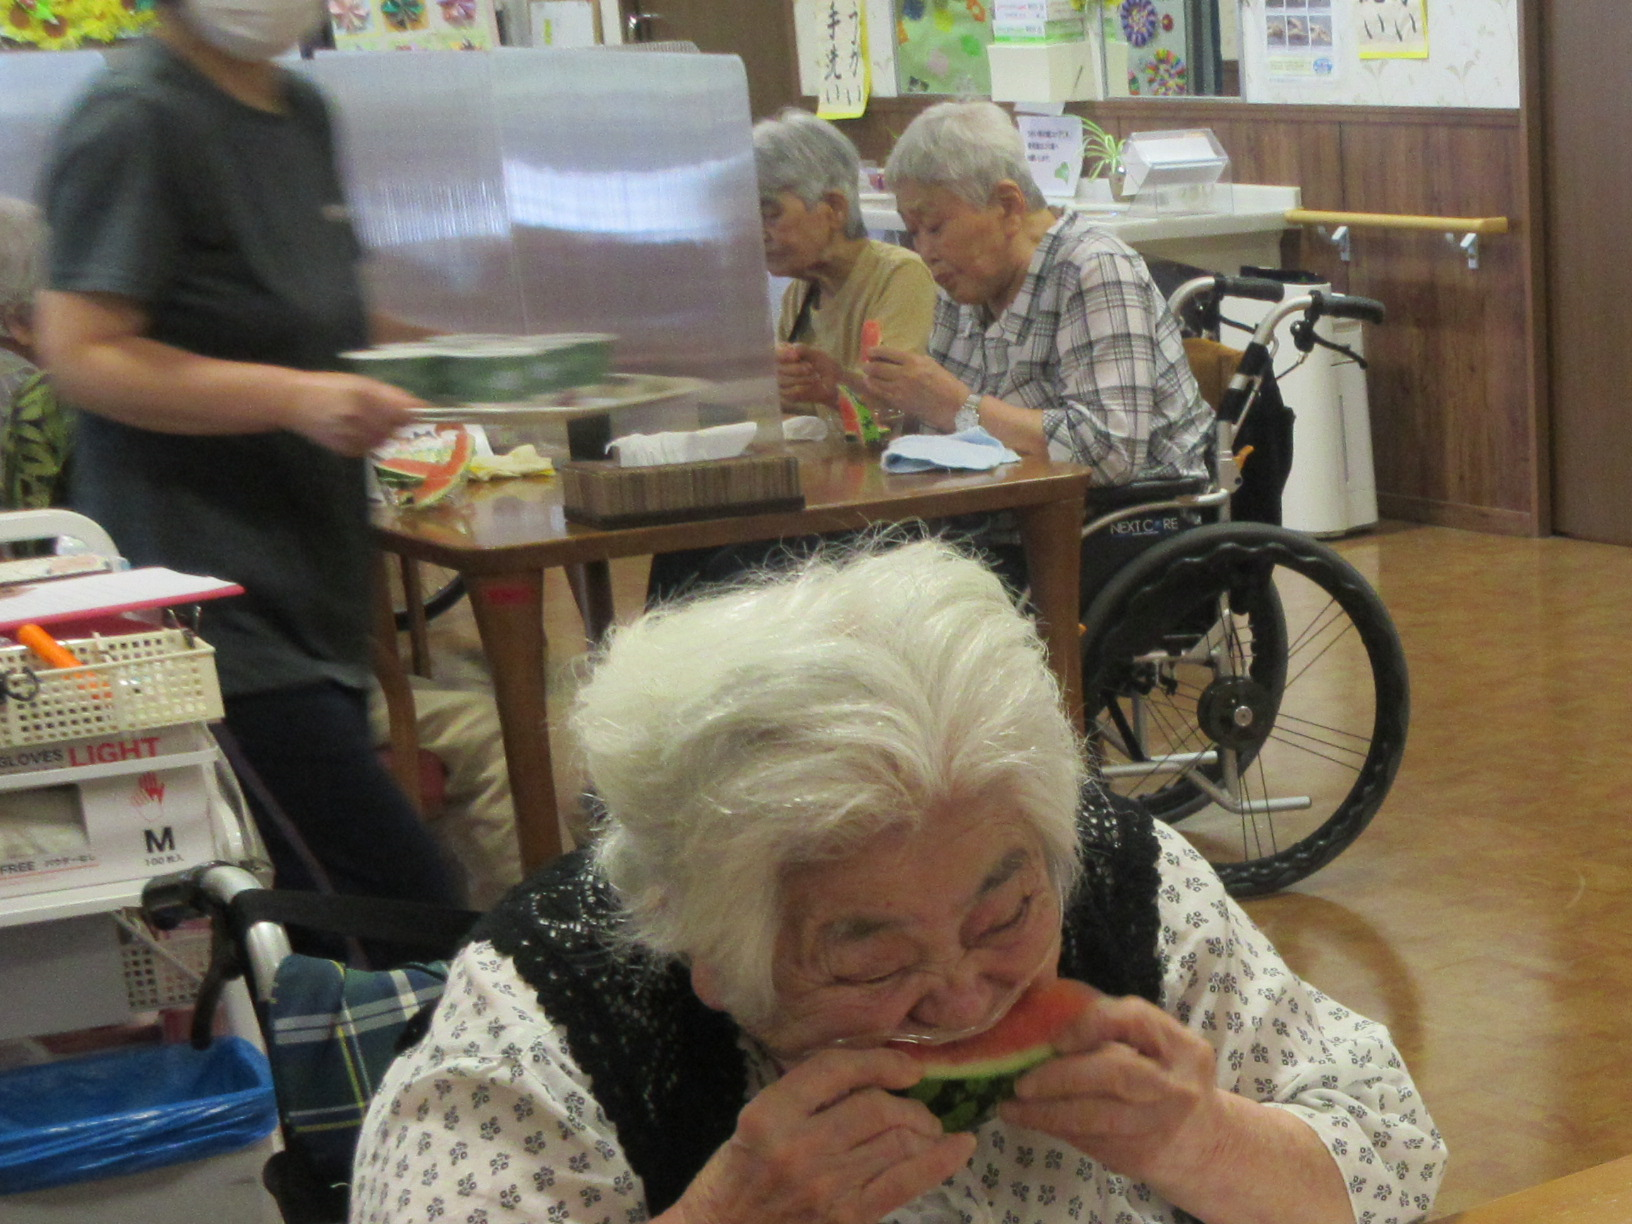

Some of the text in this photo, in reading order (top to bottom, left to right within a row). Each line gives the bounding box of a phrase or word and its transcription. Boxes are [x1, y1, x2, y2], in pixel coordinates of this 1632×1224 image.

[67, 737, 162, 767] LIGHT
[143, 826, 176, 853] M
[1, 861, 36, 875] FREE
